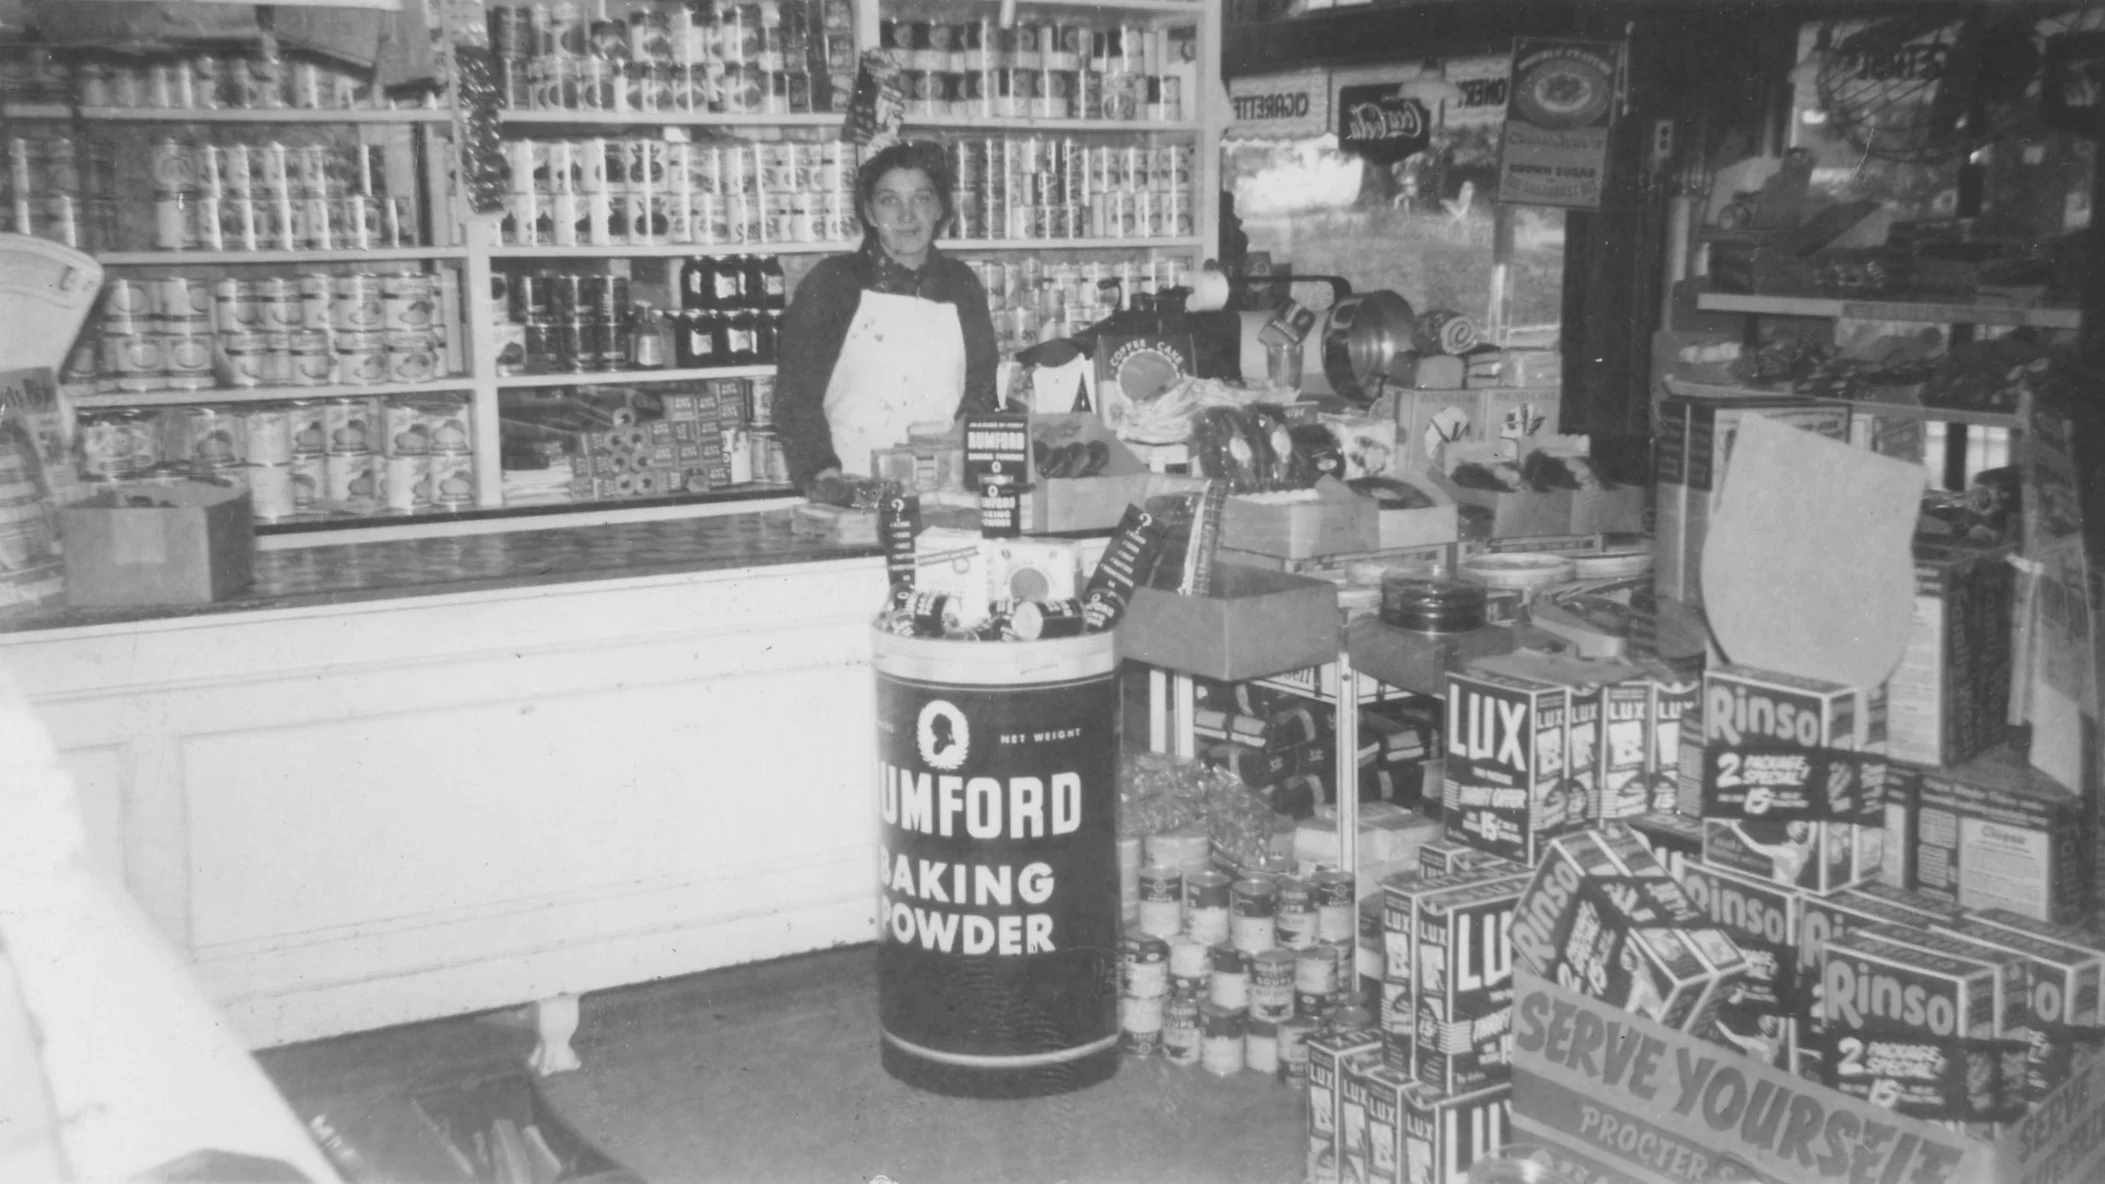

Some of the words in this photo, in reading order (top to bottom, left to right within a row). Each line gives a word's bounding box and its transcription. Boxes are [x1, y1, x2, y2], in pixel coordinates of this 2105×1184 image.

[1110, 339, 1146, 366] COFFEE
[1157, 341, 1184, 365] CAKE
[968, 432, 1025, 450] RUMFORD
[1536, 708, 1565, 729] LUX
[1571, 703, 1598, 724] LUX
[1609, 701, 1645, 719] LUX
[1708, 685, 1819, 748] Rinso
[1000, 732, 1027, 745] NET
[1033, 727, 1082, 743] WEIGHT
[1449, 684, 1527, 770] LUX
[1717, 752, 1741, 788] 2
[881, 761, 1082, 839] UMFORD
[1384, 908, 1410, 933] LUX
[1419, 920, 1447, 946] LUX
[1512, 861, 1580, 975] Rinso
[1457, 911, 1513, 991] LU
[1826, 959, 1954, 1036] Rinso
[1515, 991, 1667, 1101] SERVE
[1837, 1037, 1863, 1075] 2
[1309, 1062, 1334, 1089] LUX
[1343, 1078, 1368, 1106] LUX
[1369, 1096, 1396, 1126] LUX
[1406, 1112, 1434, 1142] LUX
[1580, 1105, 1710, 1181] PROCTER
